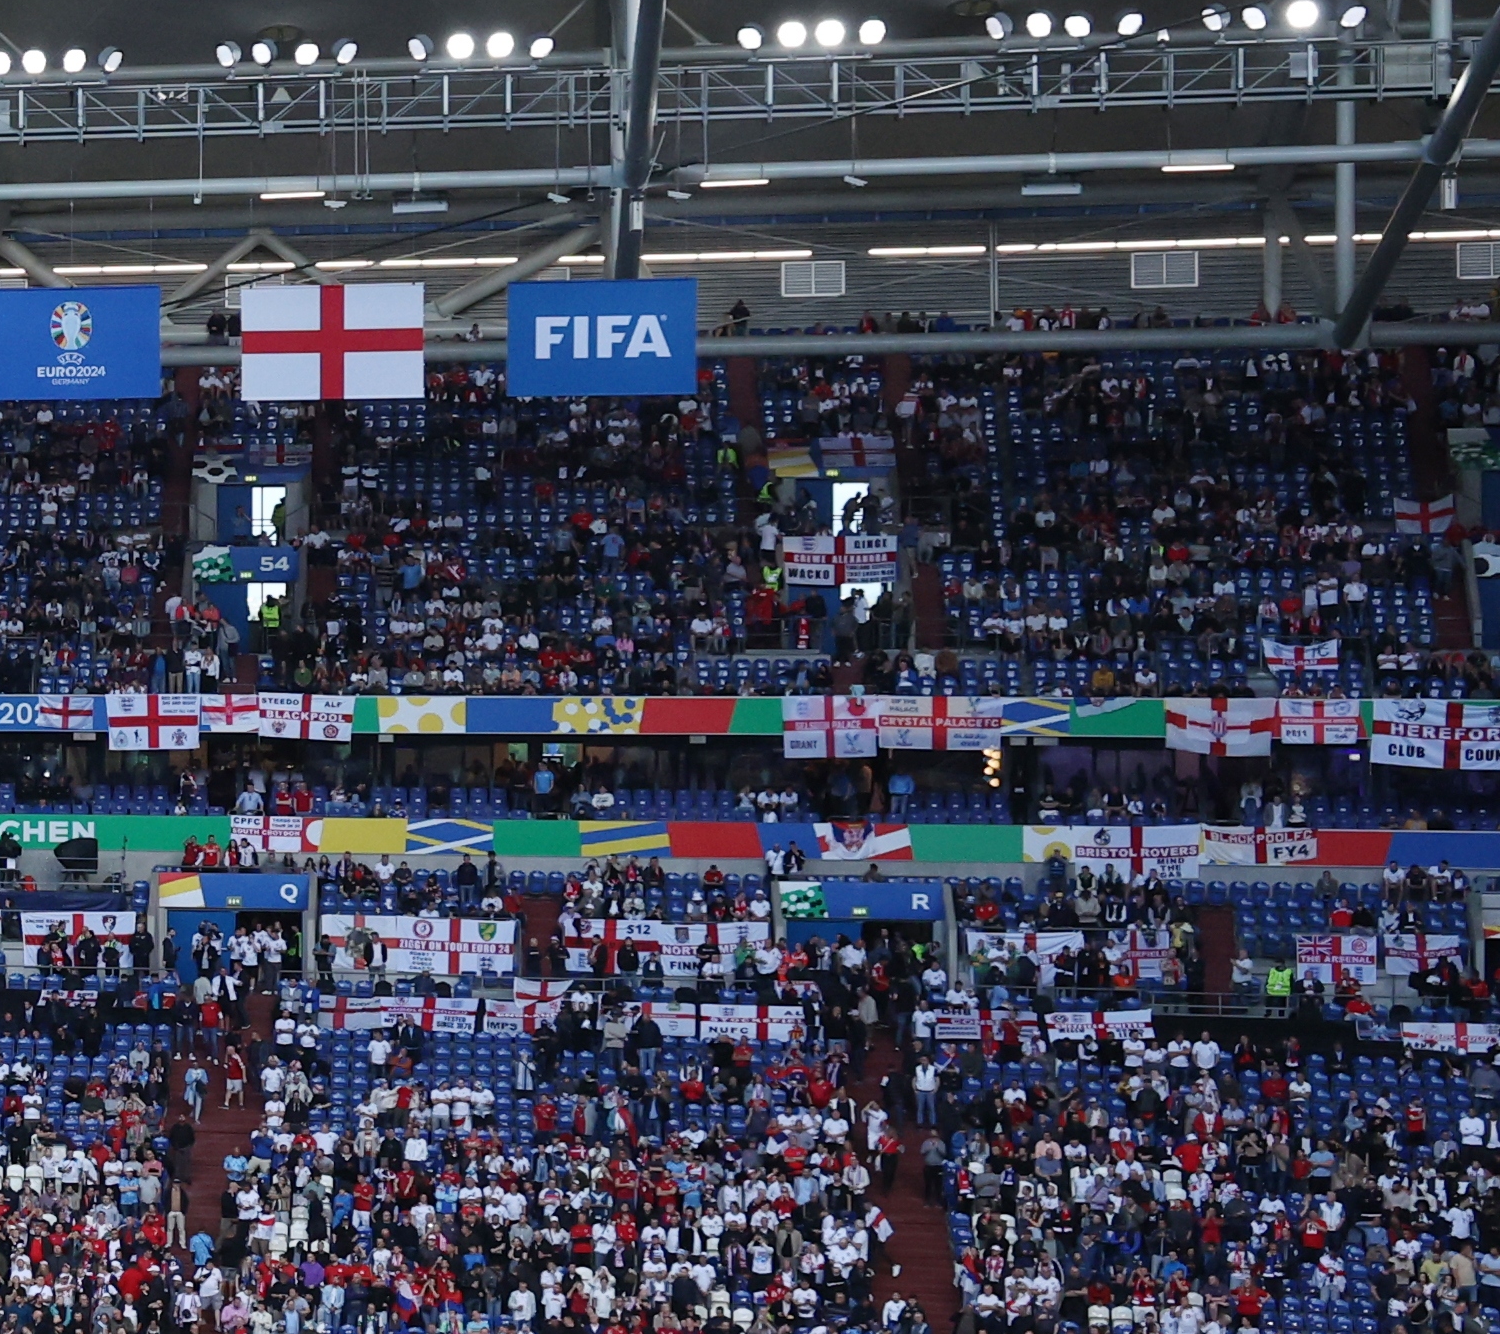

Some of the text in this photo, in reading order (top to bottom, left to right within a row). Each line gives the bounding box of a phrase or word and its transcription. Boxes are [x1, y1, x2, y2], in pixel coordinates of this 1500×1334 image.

[534, 315, 671, 359] FIFA
[57, 352, 85, 365] UEFA
[260, 556, 290, 571] 54
[788, 568, 830, 580] WACKO
[261, 697, 299, 706] STEEDO
[266, 710, 345, 722] BLACKPOOL
[881, 716, 999, 728] CRYSTAL PALACE FC
[1388, 744, 1425, 758] CLUB
[233, 817, 260, 826] CPFC
[1077, 846, 1197, 858] BRISTOL ROVERS
[1273, 845, 1308, 859] FY4
[280, 883, 298, 903] Q
[911, 893, 929, 910] R
[627, 924, 650, 935] S12
[399, 939, 510, 953] ZIGGY ON TOUR EURO 24
[1300, 955, 1371, 964] THE ARSENAL
[487, 1019, 518, 1031] IMPS
[708, 1026, 749, 1034] NUFC
